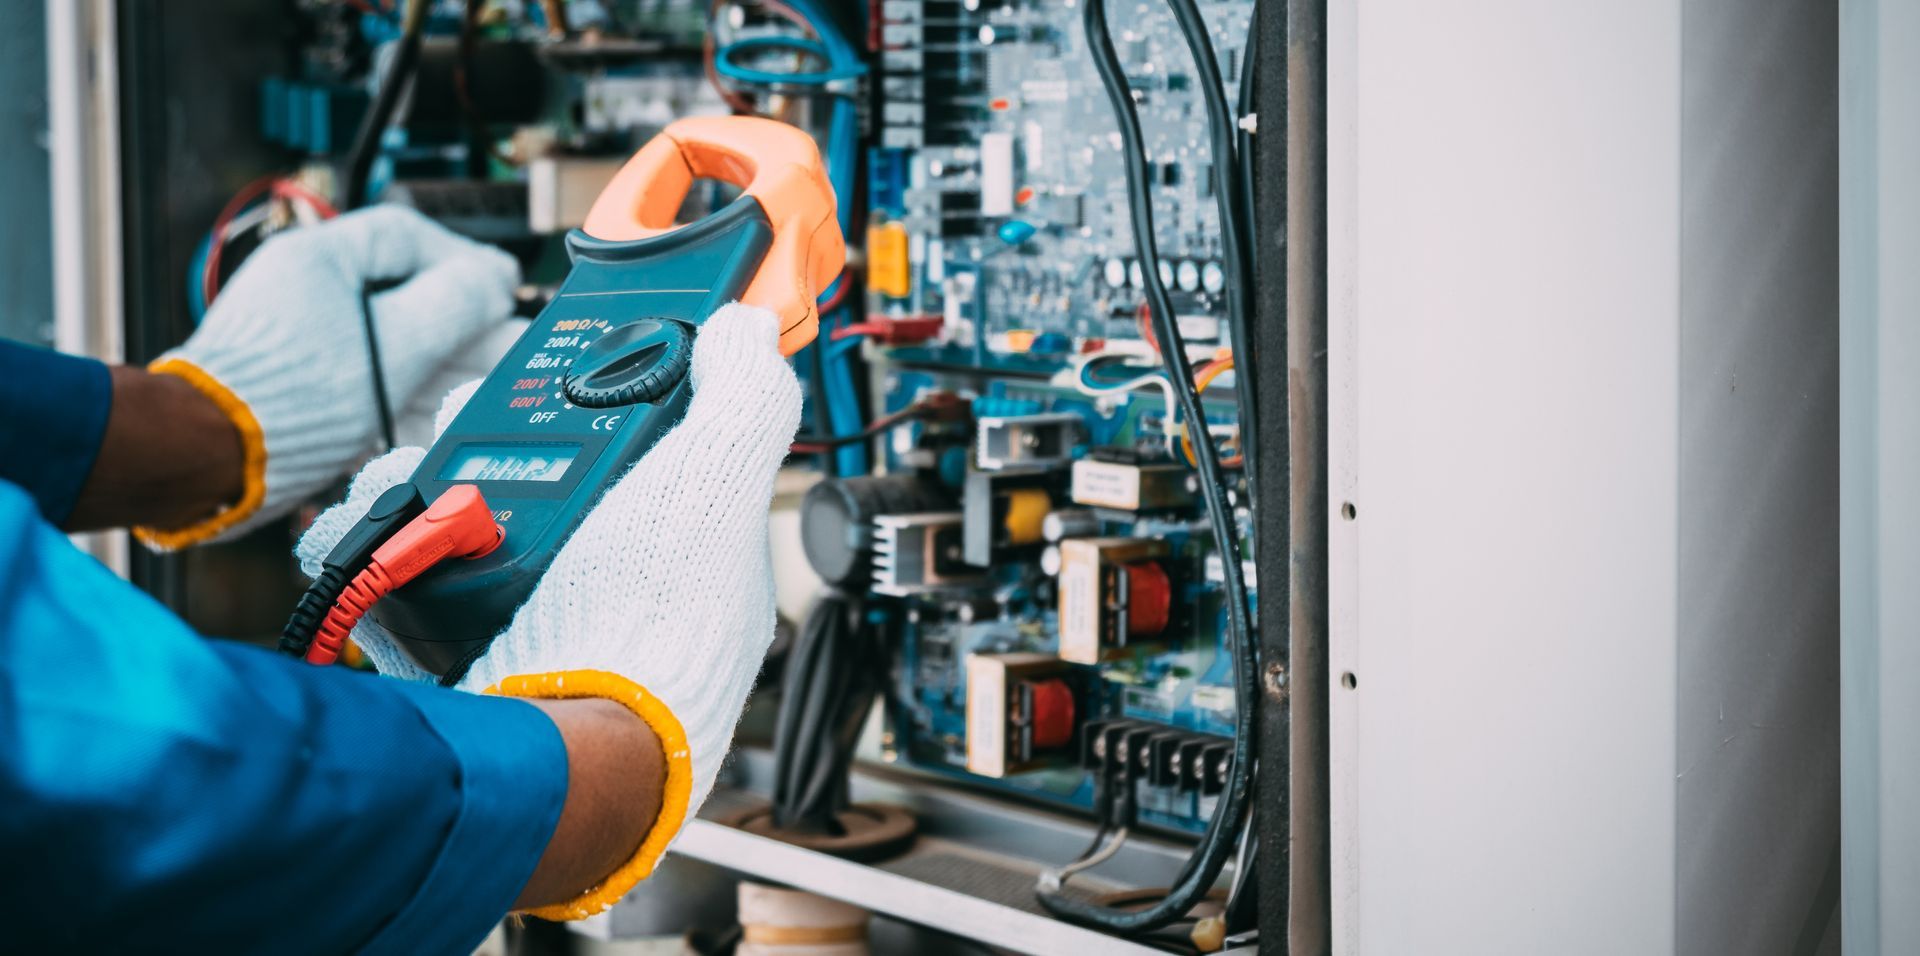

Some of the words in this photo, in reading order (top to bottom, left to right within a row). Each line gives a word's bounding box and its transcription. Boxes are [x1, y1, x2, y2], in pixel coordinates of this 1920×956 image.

[511, 378, 550, 390] 200V
[509, 396, 545, 408] 600V
[528, 411, 559, 424] OFF
[591, 415, 621, 430] CE
